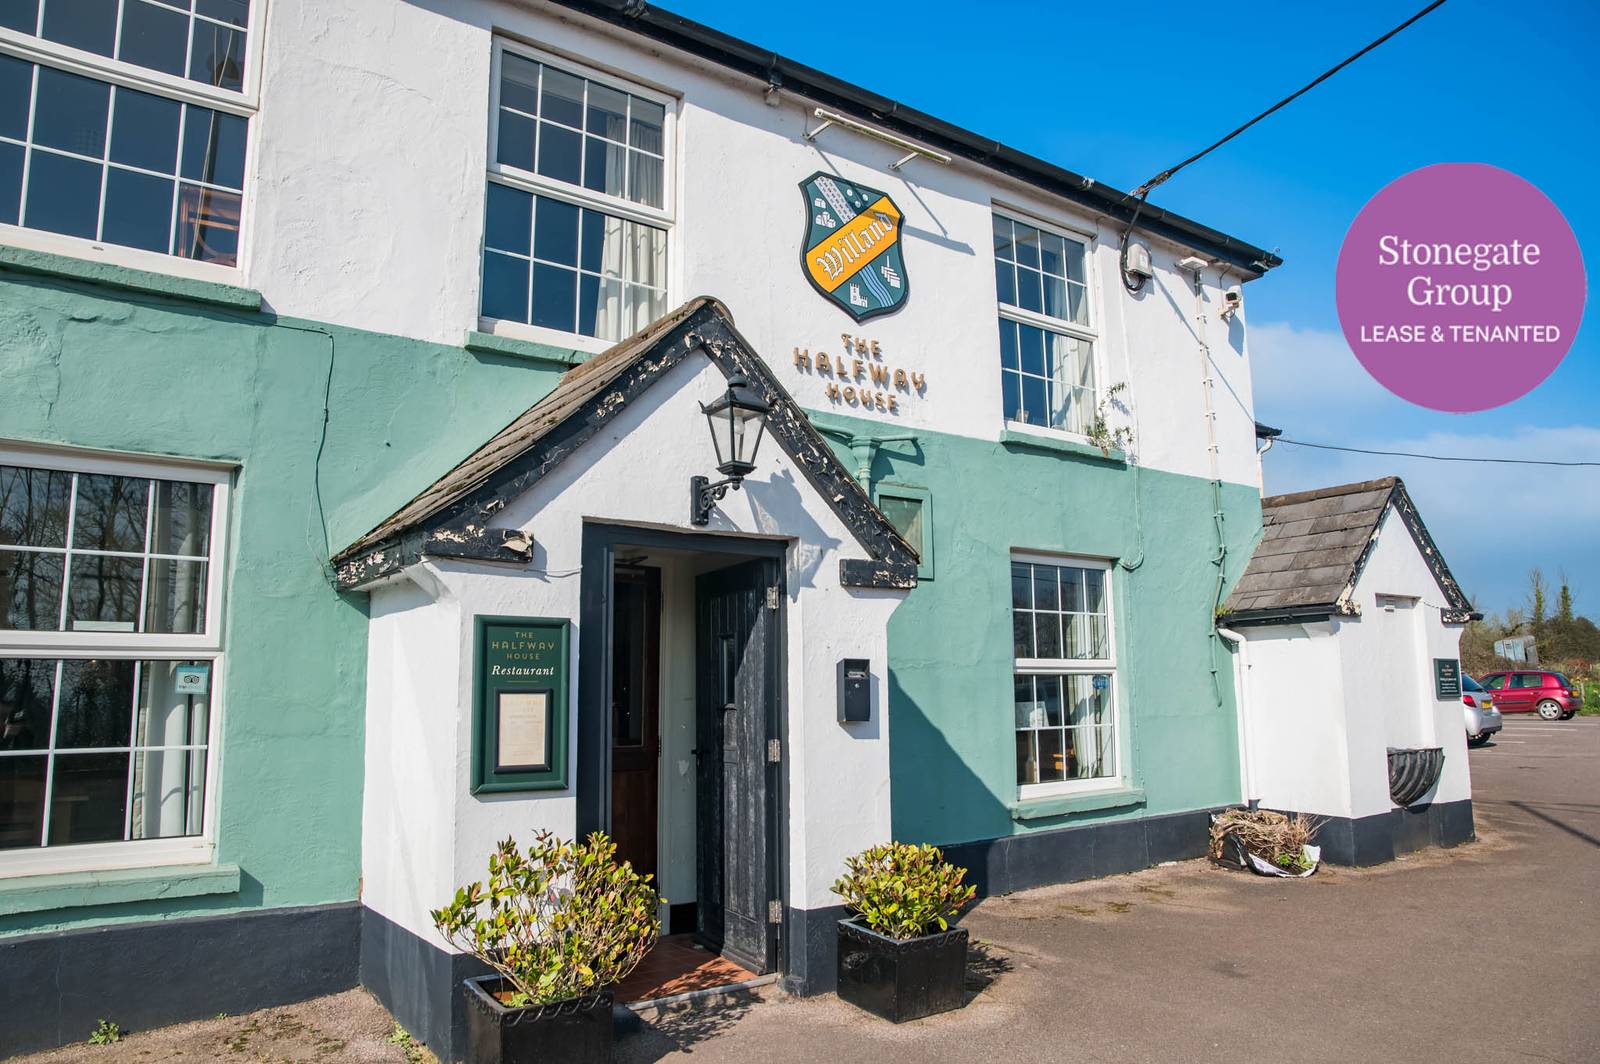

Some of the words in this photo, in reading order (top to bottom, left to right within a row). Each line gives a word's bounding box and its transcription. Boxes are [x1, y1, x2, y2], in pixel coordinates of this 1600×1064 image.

[816, 211, 893, 281] Willand
[841, 333, 881, 360] THE
[793, 346, 925, 392] HALFWAY
[825, 382, 898, 412] HOUSE
[515, 631, 534, 639] THE
[491, 641, 555, 650] HALFWAY
[506, 652, 541, 660] HOUSE
[491, 664, 555, 676] Restaurant
